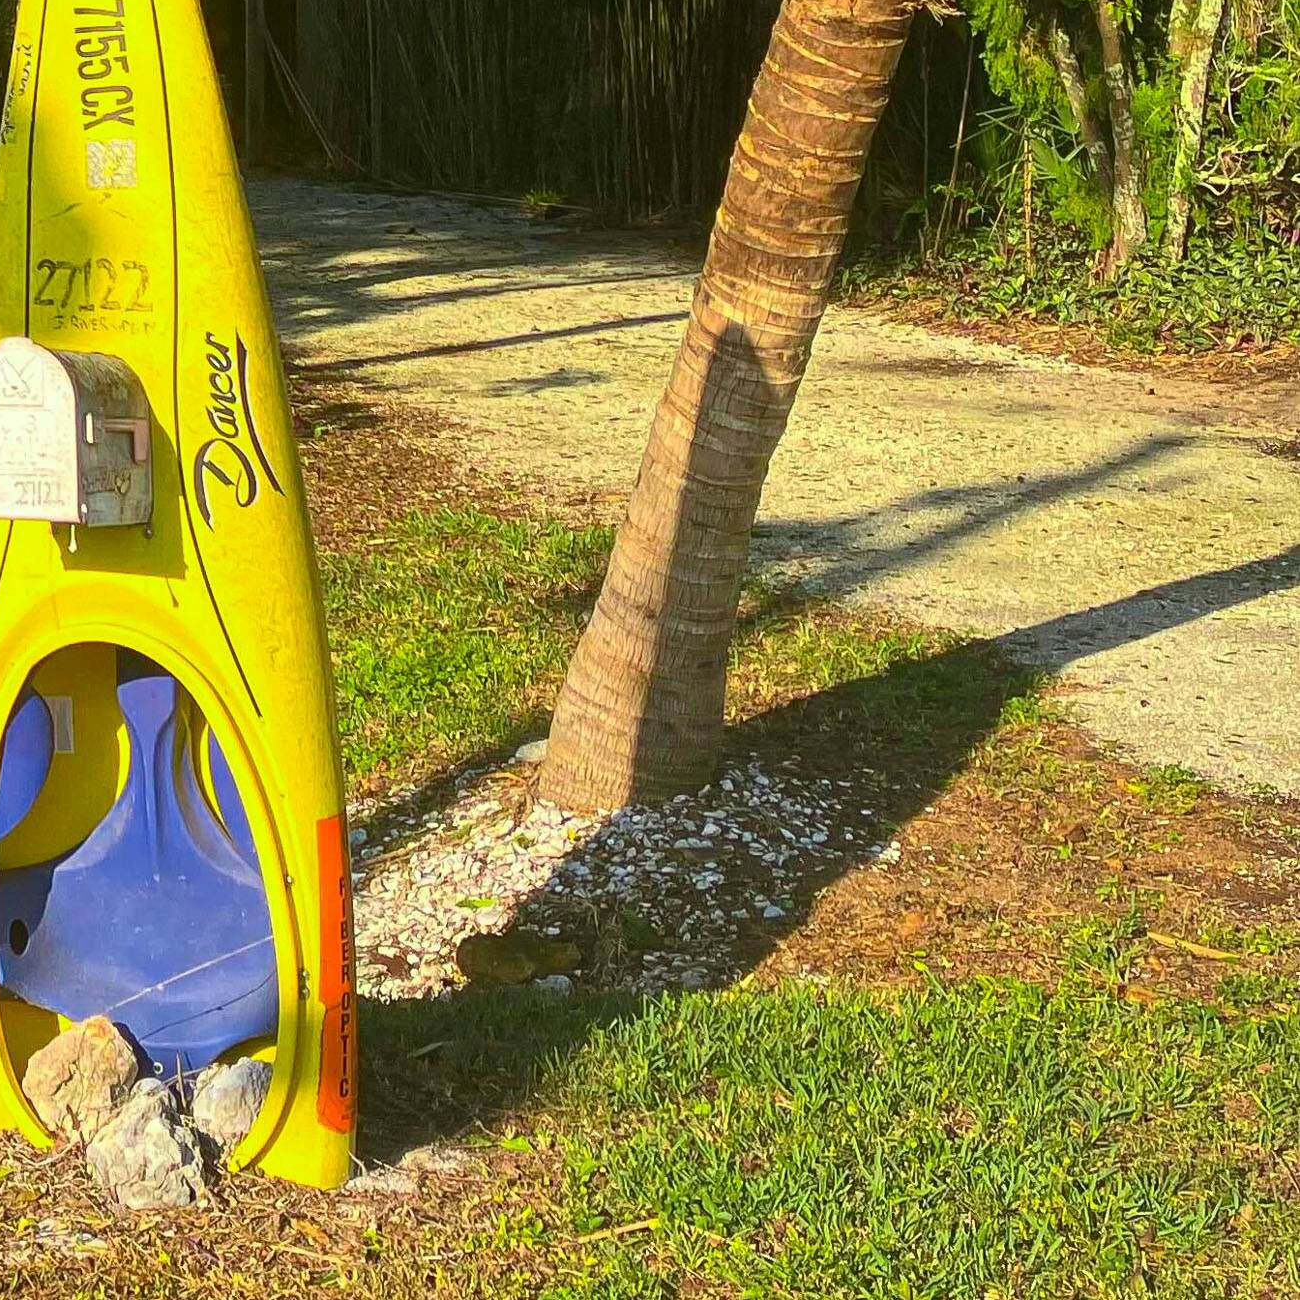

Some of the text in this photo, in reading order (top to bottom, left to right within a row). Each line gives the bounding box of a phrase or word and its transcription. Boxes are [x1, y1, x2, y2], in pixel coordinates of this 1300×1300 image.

[33, 257, 154, 312] 27122
[193, 331, 258, 533] Dancer
[338, 991, 351, 1099] OPTIC
